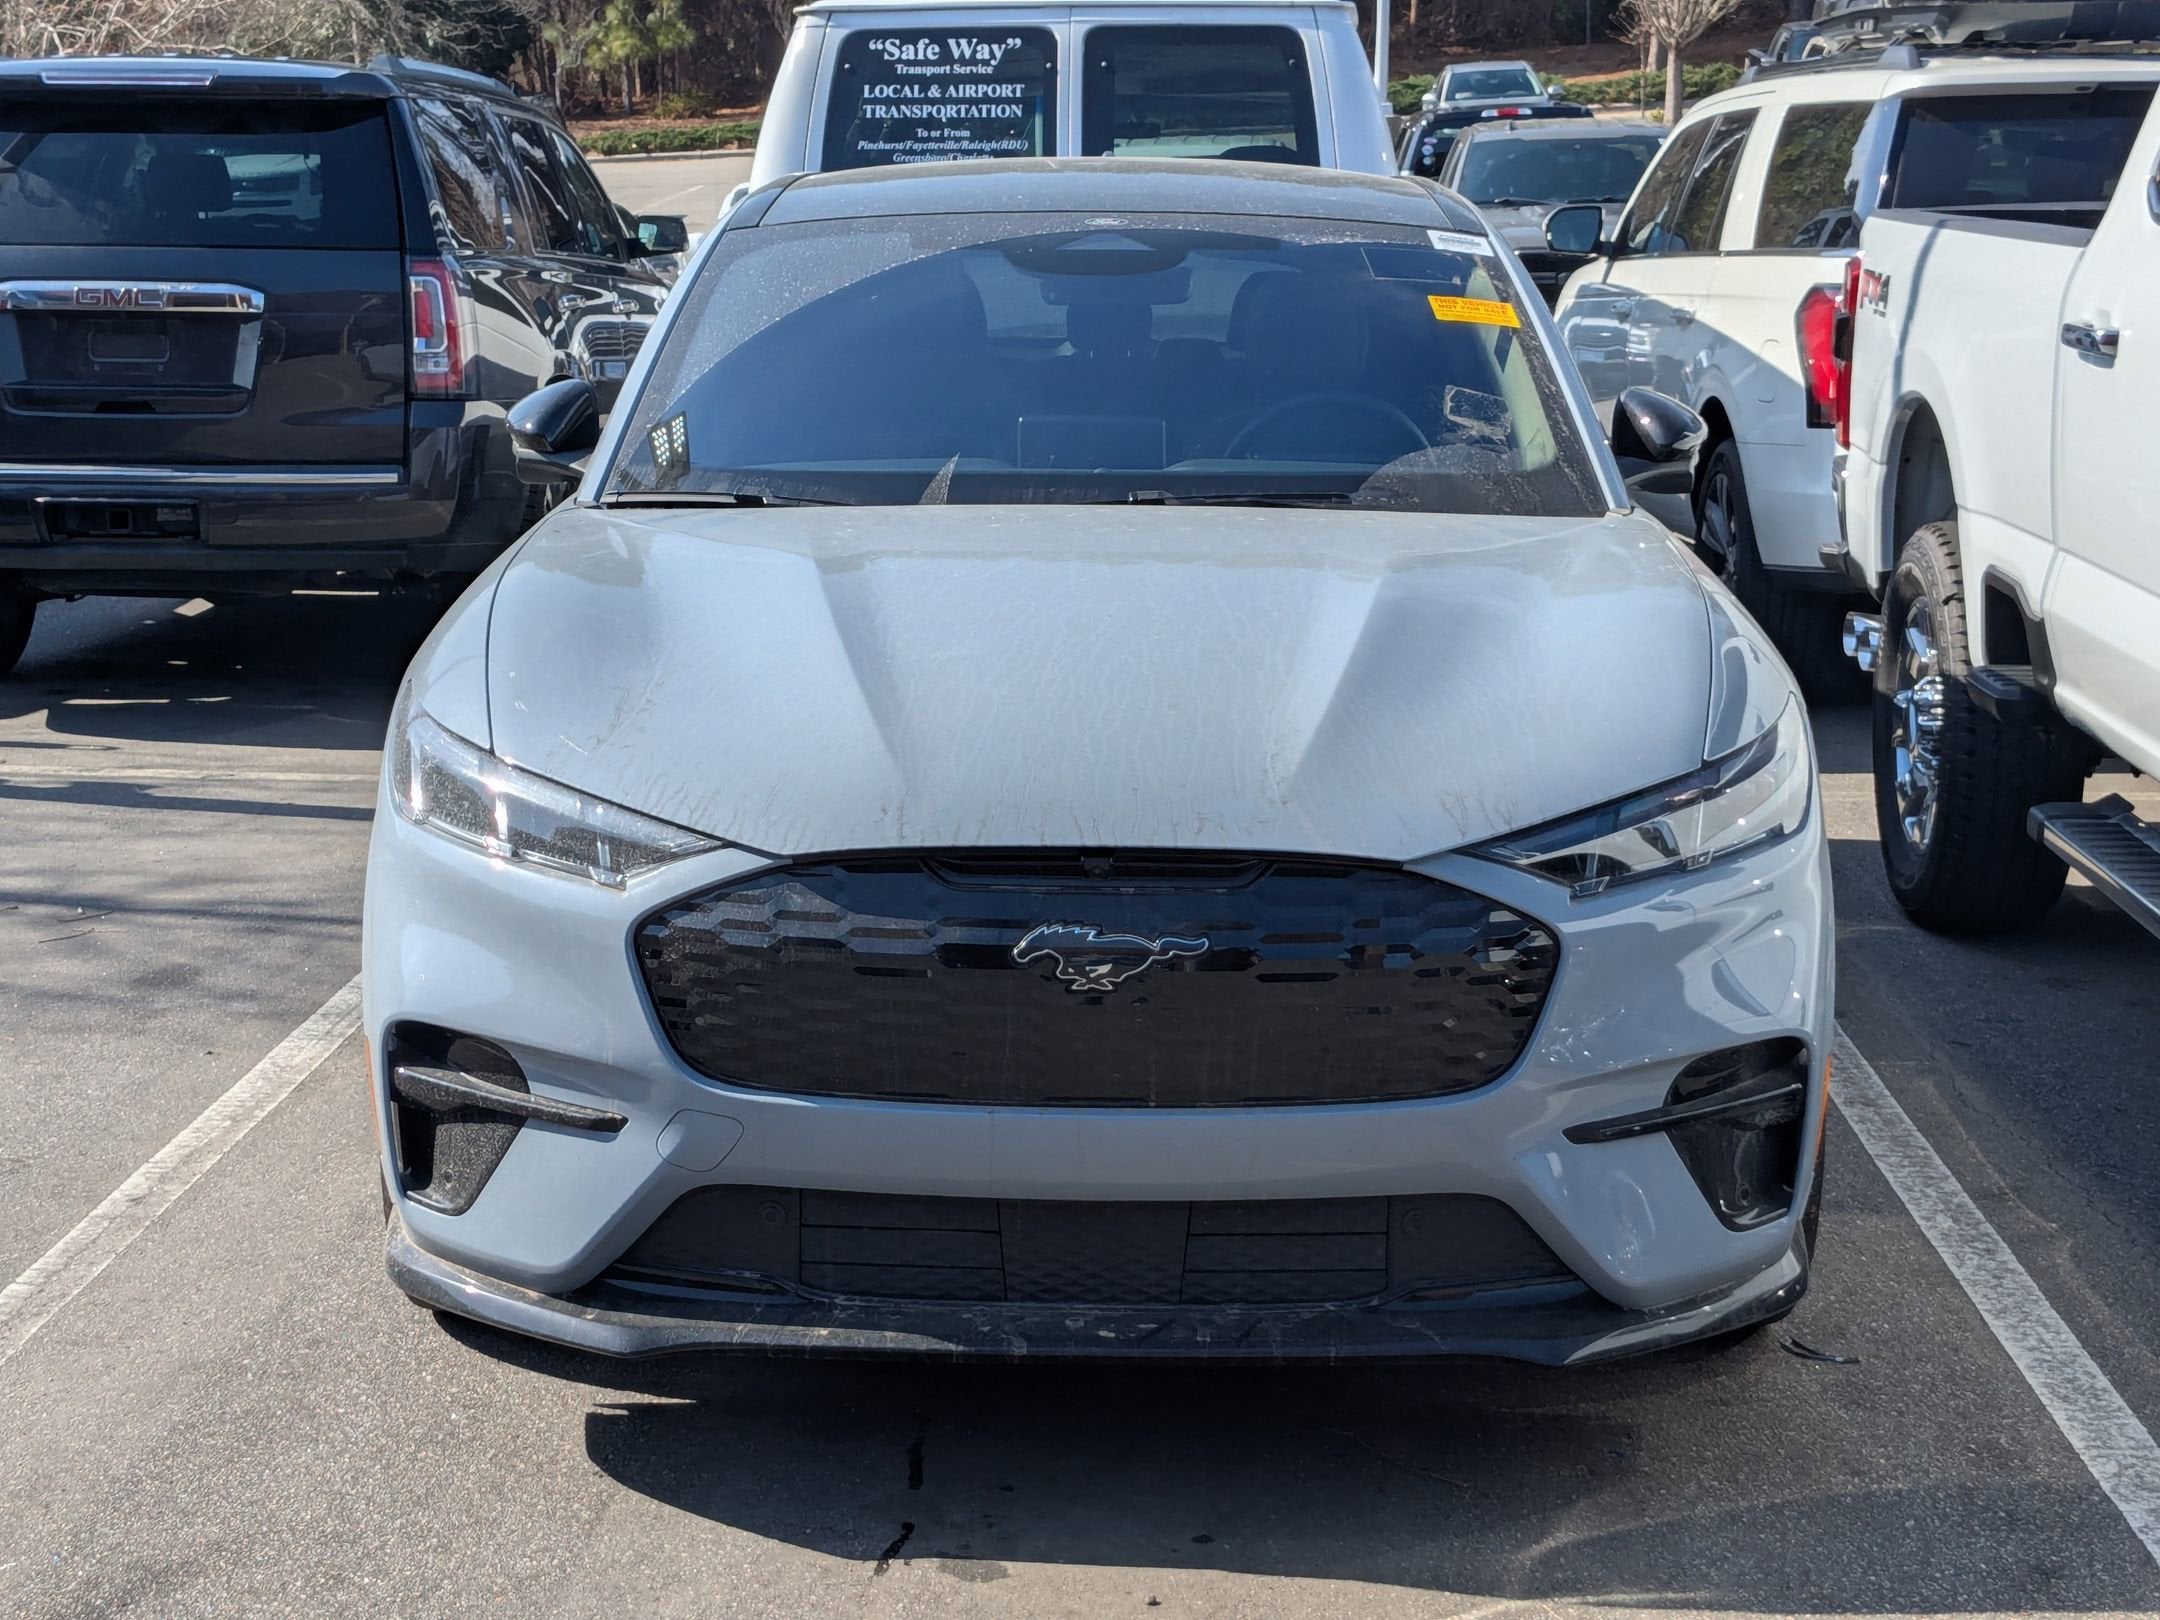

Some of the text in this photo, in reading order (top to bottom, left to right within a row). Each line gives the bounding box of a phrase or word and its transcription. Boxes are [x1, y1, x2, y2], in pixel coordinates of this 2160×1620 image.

[894, 63, 994, 76] Transport Service
[863, 83, 1025, 98] LOCAL & AIRPORT
[863, 104, 1023, 118] TRANSPORTATION
[915, 128, 971, 138] To or From
[857, 140, 1029, 152] Pinehurst/Fayetteville/Raleigh(RDU)
[74, 287, 165, 308] GMC
